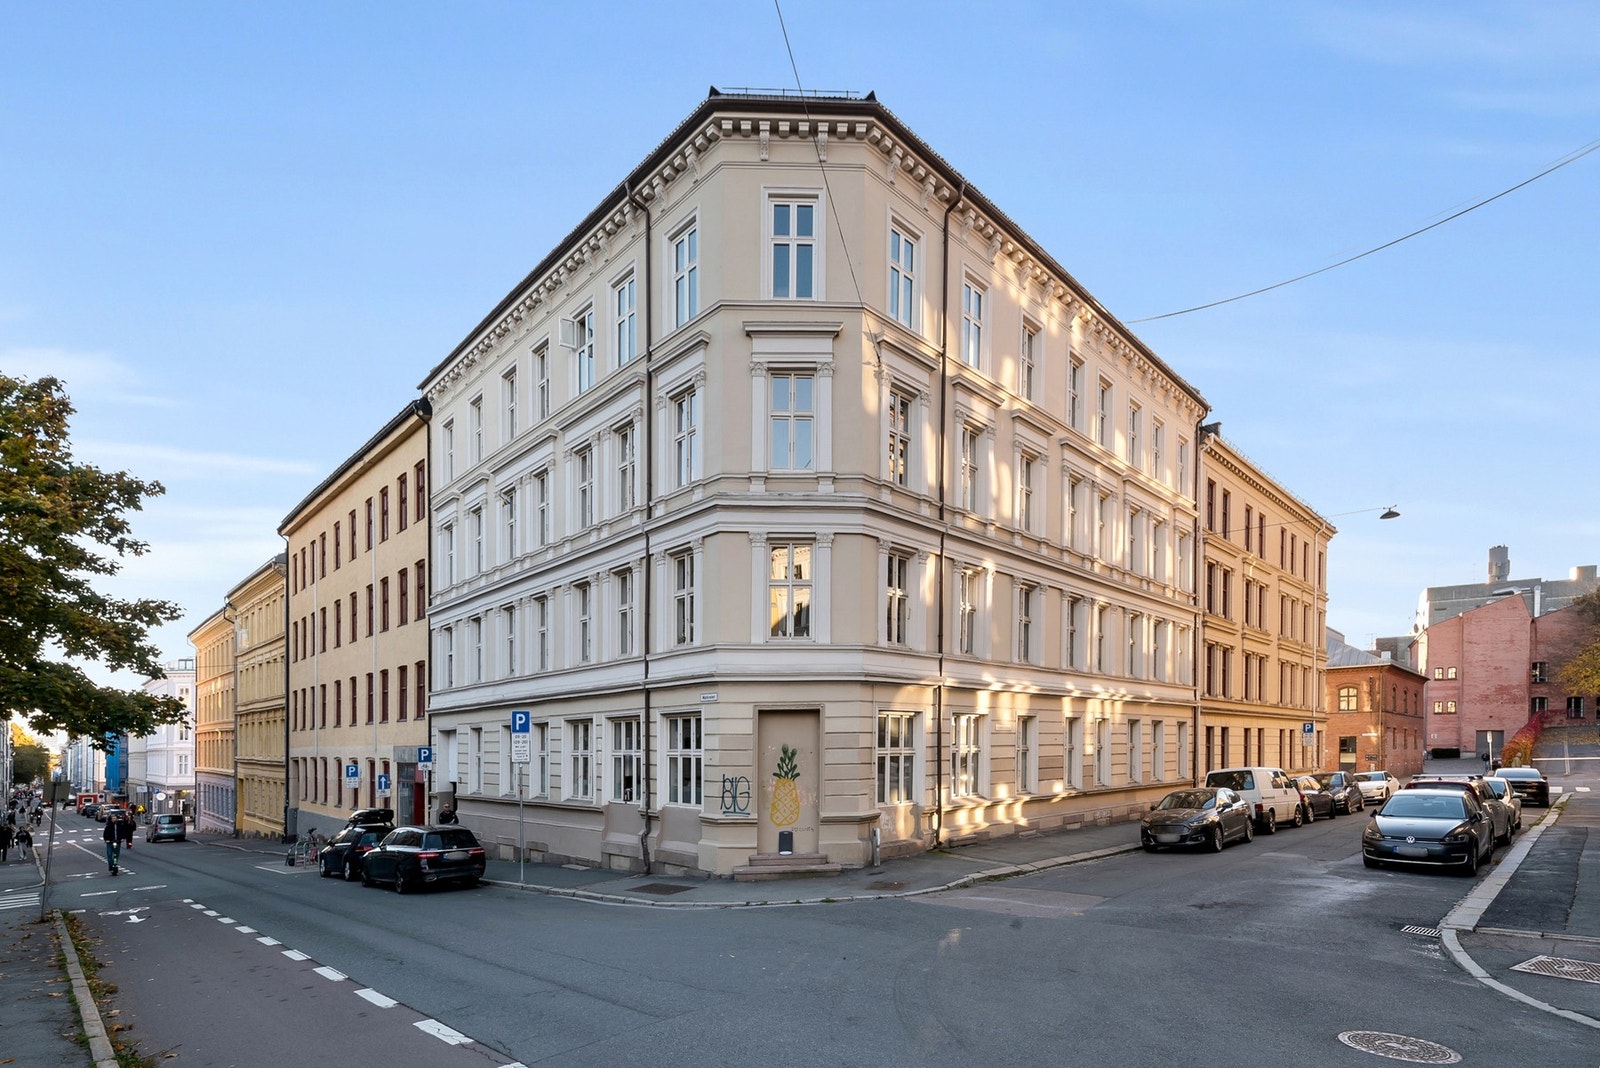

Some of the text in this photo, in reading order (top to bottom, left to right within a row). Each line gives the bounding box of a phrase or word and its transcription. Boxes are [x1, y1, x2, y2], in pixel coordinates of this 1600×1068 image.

[516, 713, 526, 731] P
[1304, 724, 1311, 732] P
[420, 749, 429, 761] P
[348, 766, 356, 776] P
